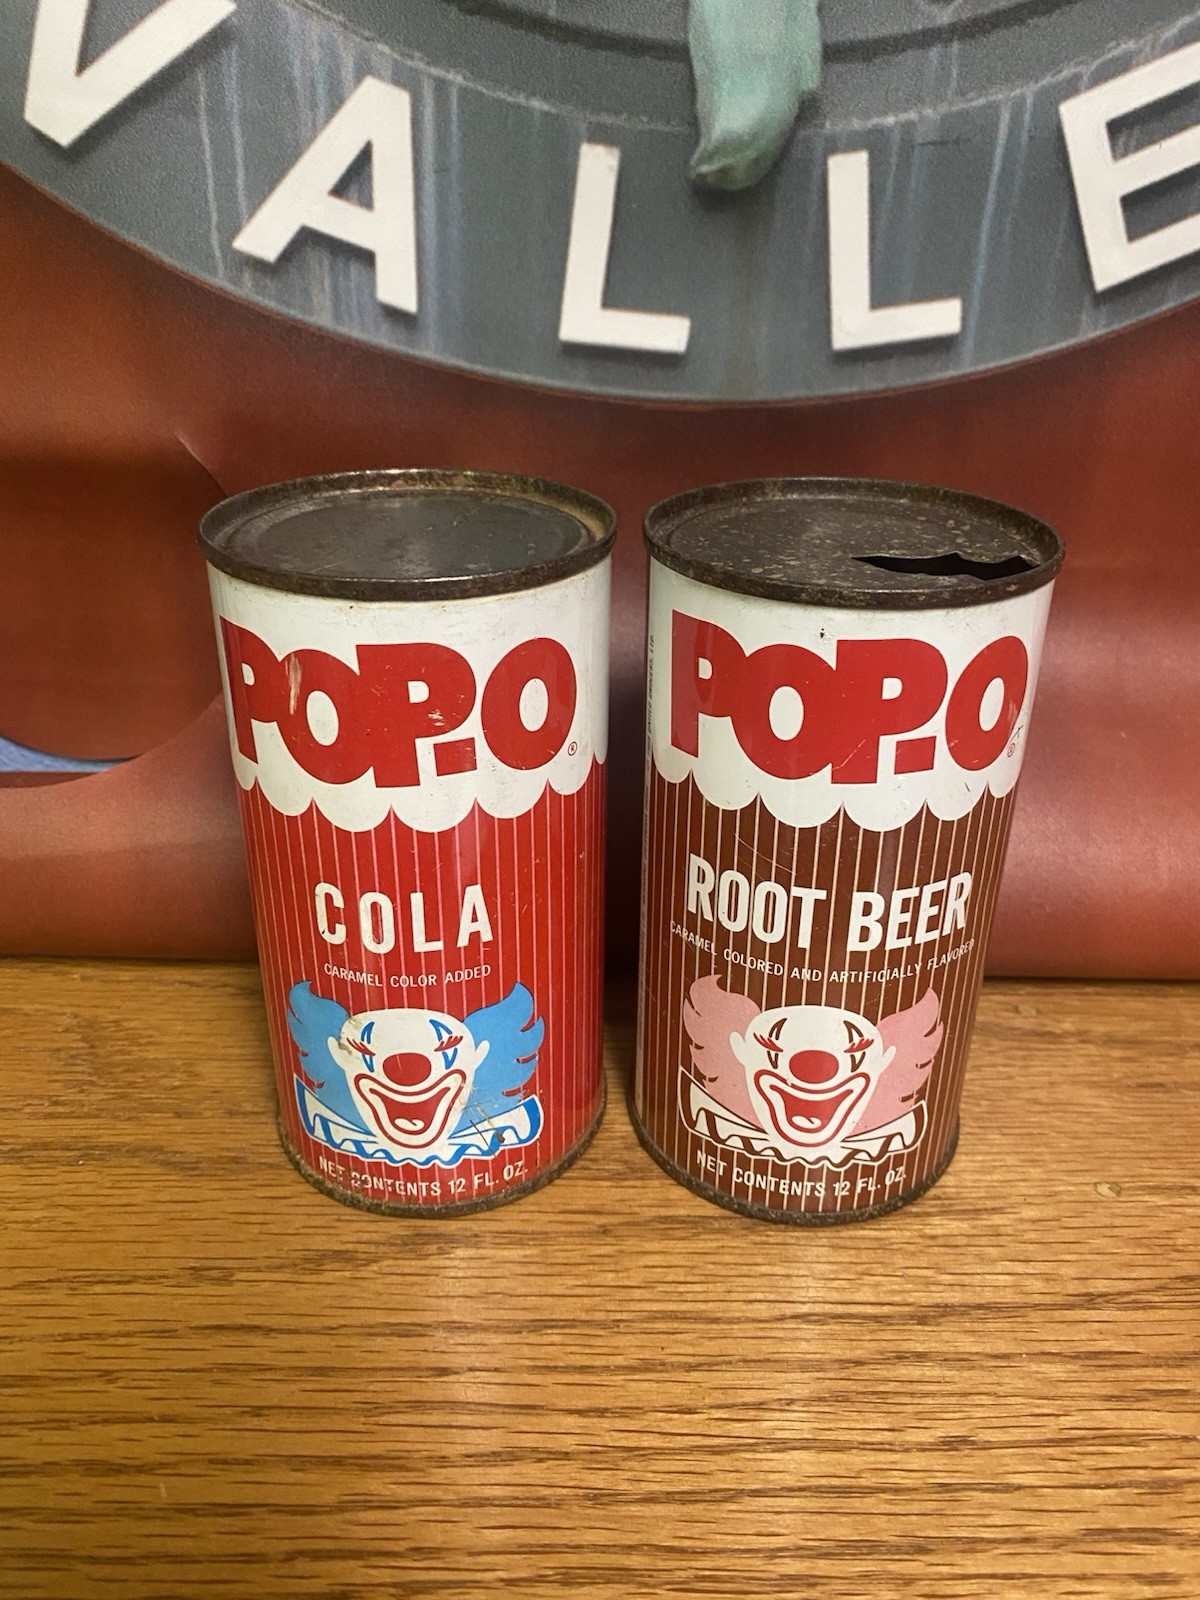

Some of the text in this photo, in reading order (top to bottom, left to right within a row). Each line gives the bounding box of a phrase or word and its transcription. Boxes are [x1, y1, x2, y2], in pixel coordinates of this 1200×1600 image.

[314, 881, 494, 955] COLA
[687, 852, 827, 949] ROOT
[846, 871, 973, 952] BEER
[323, 962, 491, 988] CARAMEL COLOR ADDED
[670, 920, 975, 983] CARAMEL COLORED AND ARTIFICIALLY FLAVORED
[318, 1155, 528, 1197] NET CONTENTS 12 FL. OZ.
[696, 1150, 907, 1197] NET CONTENTS 12 FL. OZ.
